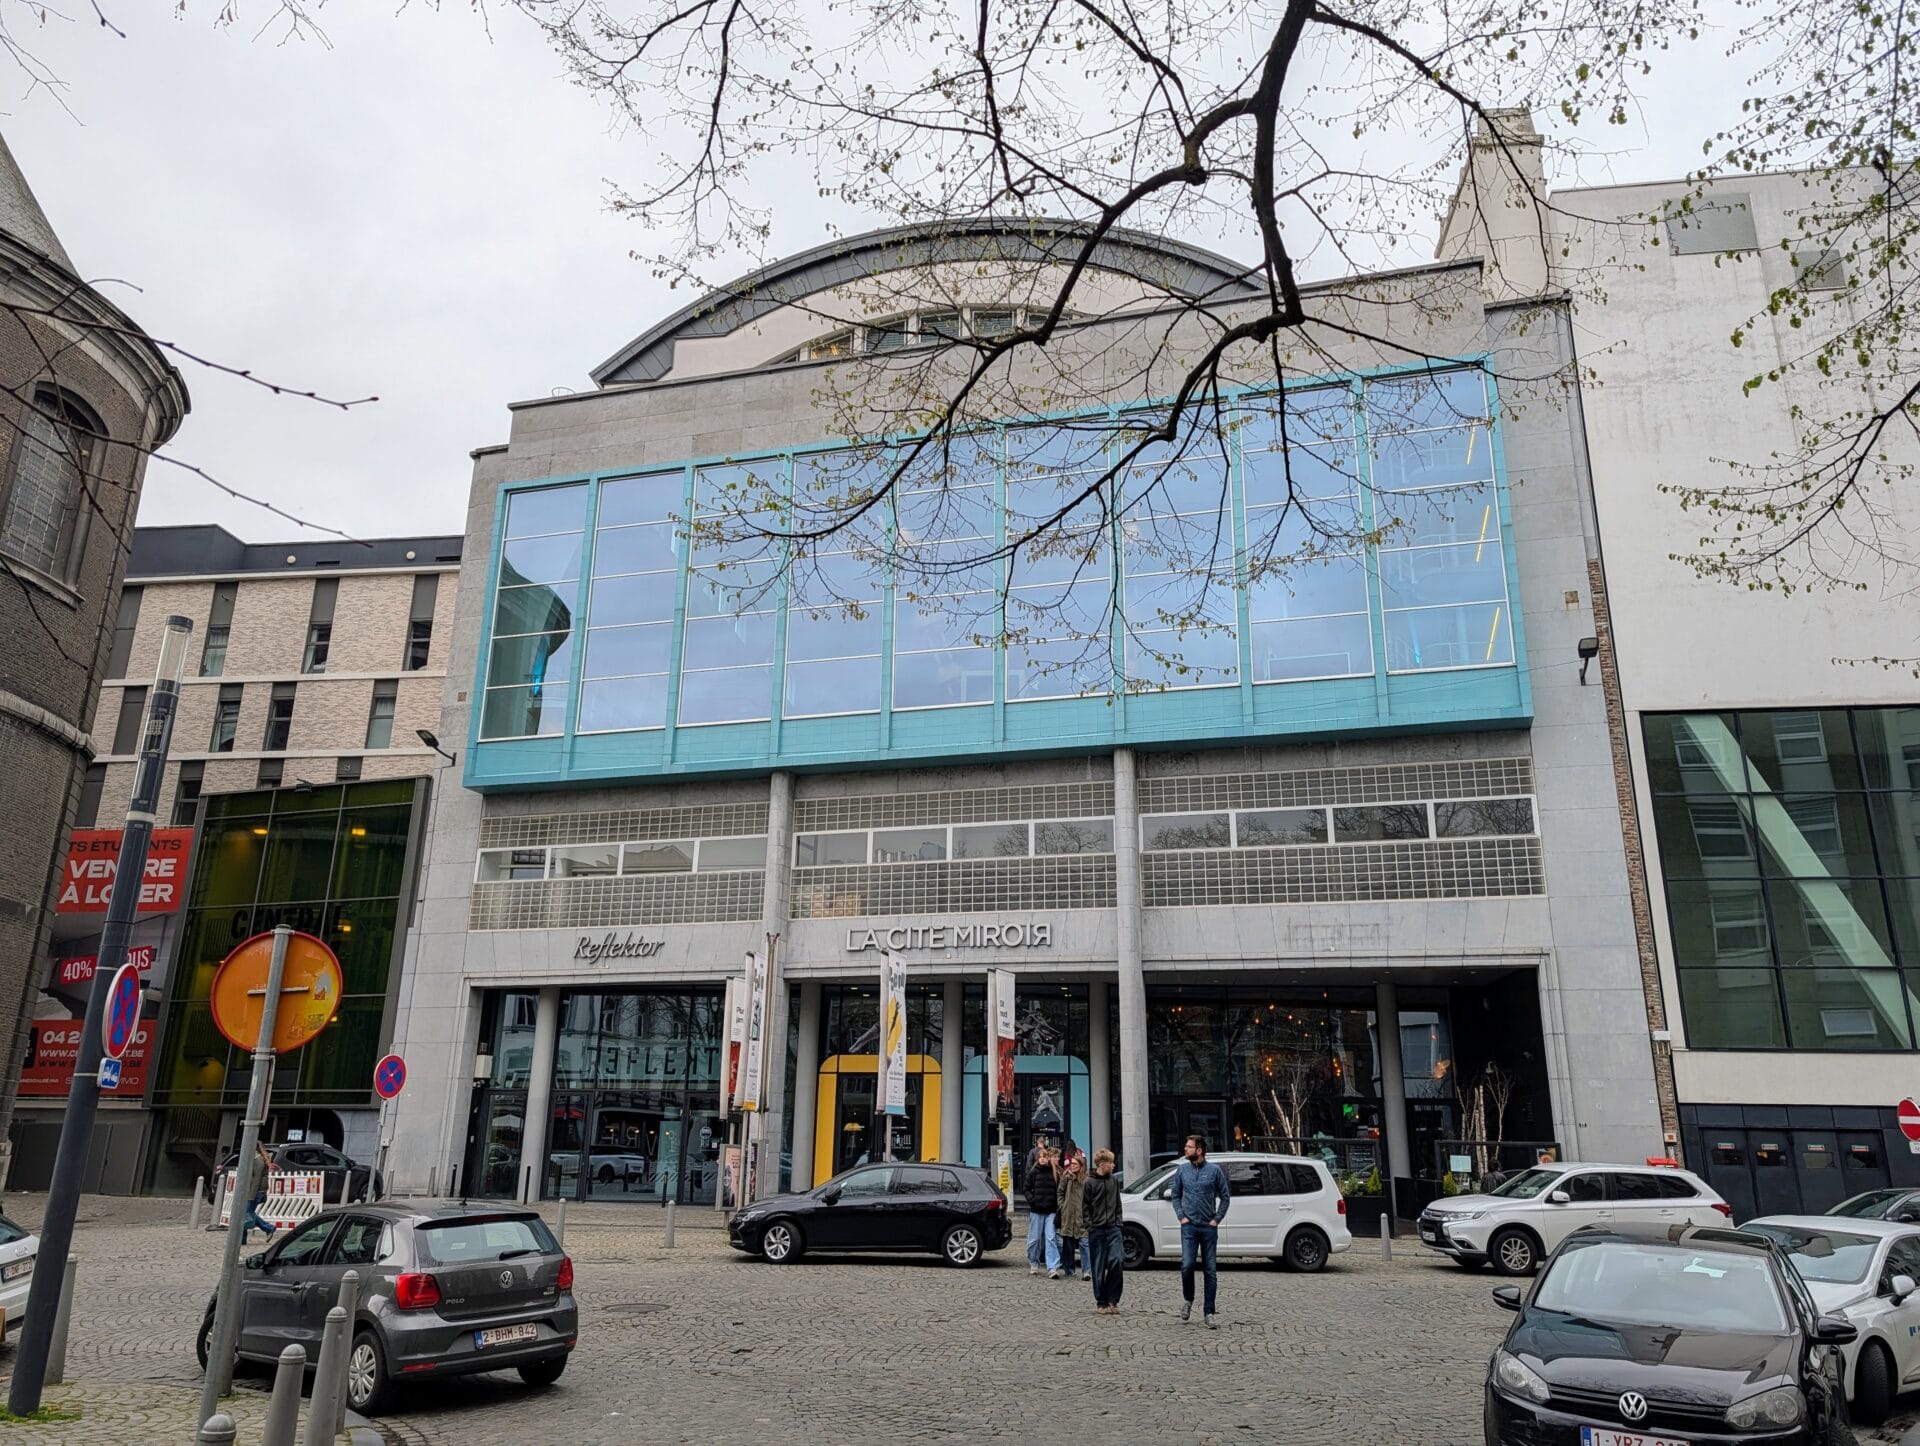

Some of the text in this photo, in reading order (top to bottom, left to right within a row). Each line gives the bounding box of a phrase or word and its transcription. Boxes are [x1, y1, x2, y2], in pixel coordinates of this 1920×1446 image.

[90, 838, 183, 852] ÉTUNTS
[69, 858, 178, 879] VENRE
[59, 881, 174, 904] À LOER
[846, 928, 880, 951] LA
[953, 922, 1051, 948] MIROIR
[574, 931, 665, 965] Reflektor
[63, 959, 92, 981] 40%
[43, 1030, 65, 1044] 04
